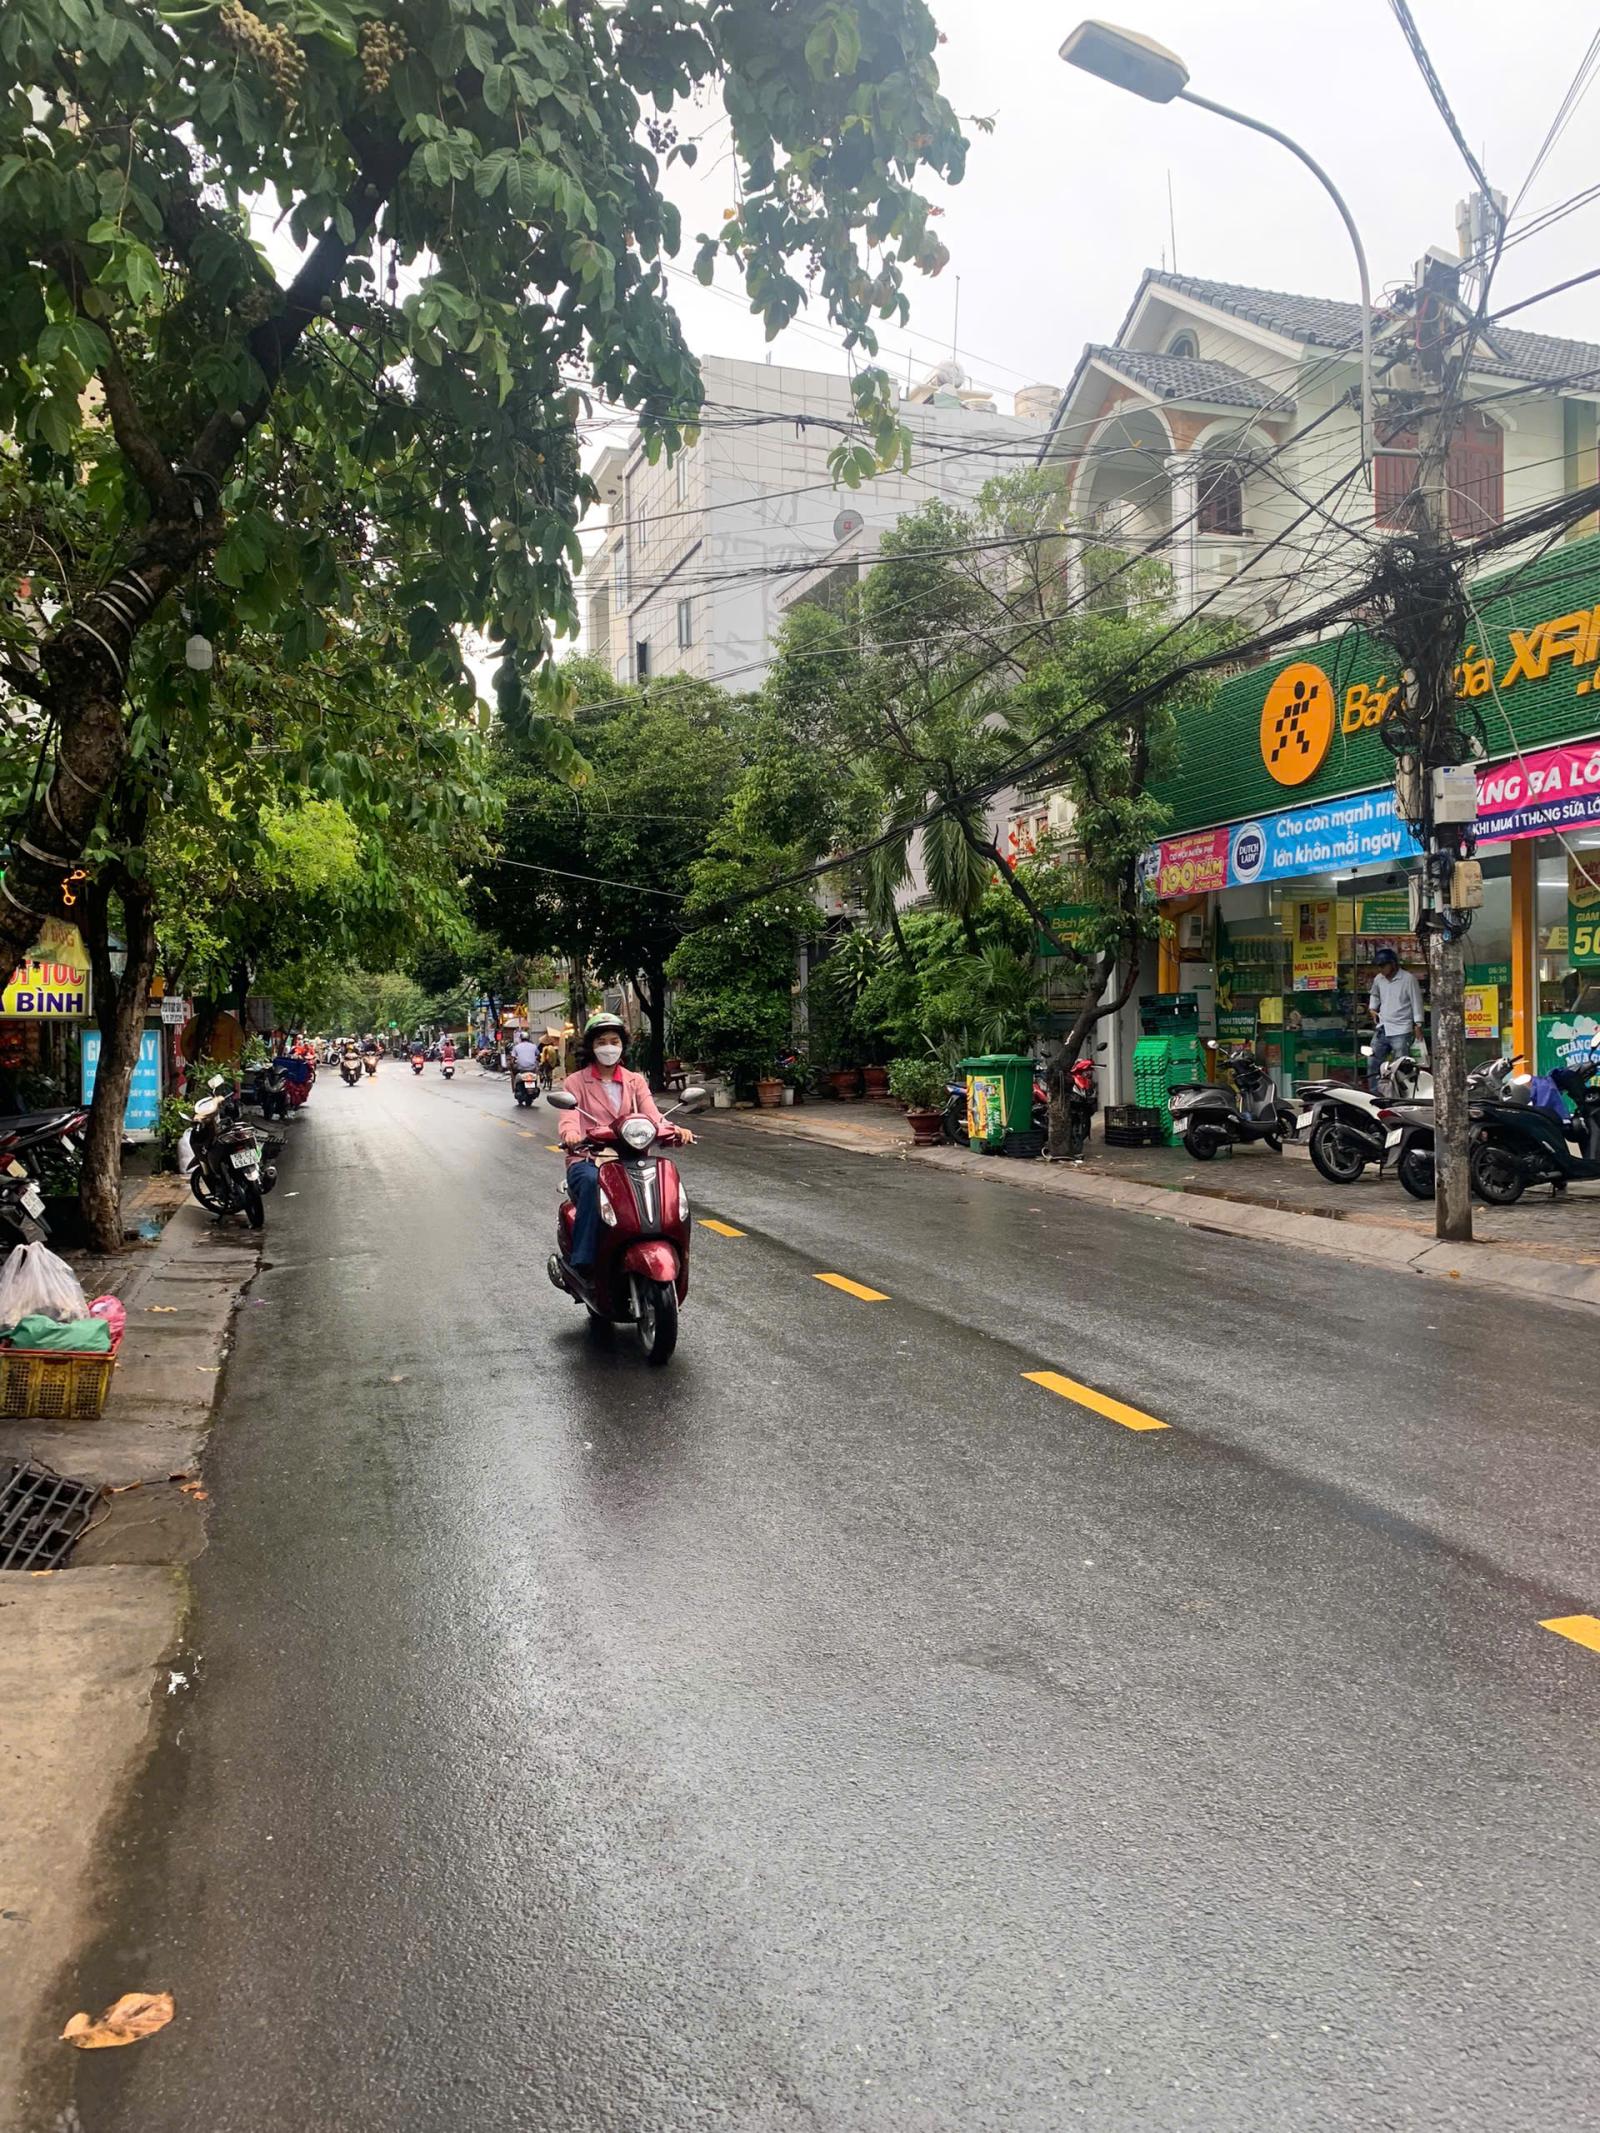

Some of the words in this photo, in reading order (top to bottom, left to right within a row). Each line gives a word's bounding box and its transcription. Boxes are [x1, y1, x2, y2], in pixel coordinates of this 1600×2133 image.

[1527, 766, 1562, 796] BA
[1276, 817, 1302, 838] Cho
[1305, 814, 1329, 831] con
[1332, 800, 1373, 828] mạnh
[1472, 820, 1490, 836] KHI
[1491, 815, 1513, 834] MUA
[1562, 800, 1585, 818] SỮA
[1240, 843, 1259, 855] DUTCH
[1241, 853, 1257, 864] LADY
[1274, 849, 1293, 867] lớn
[1295, 841, 1330, 864] khôn
[1333, 829, 1359, 856] mỗi
[1361, 831, 1401, 856] ngày
[1160, 859, 1195, 896] 100
[16, 987, 84, 1013] BÌNH
